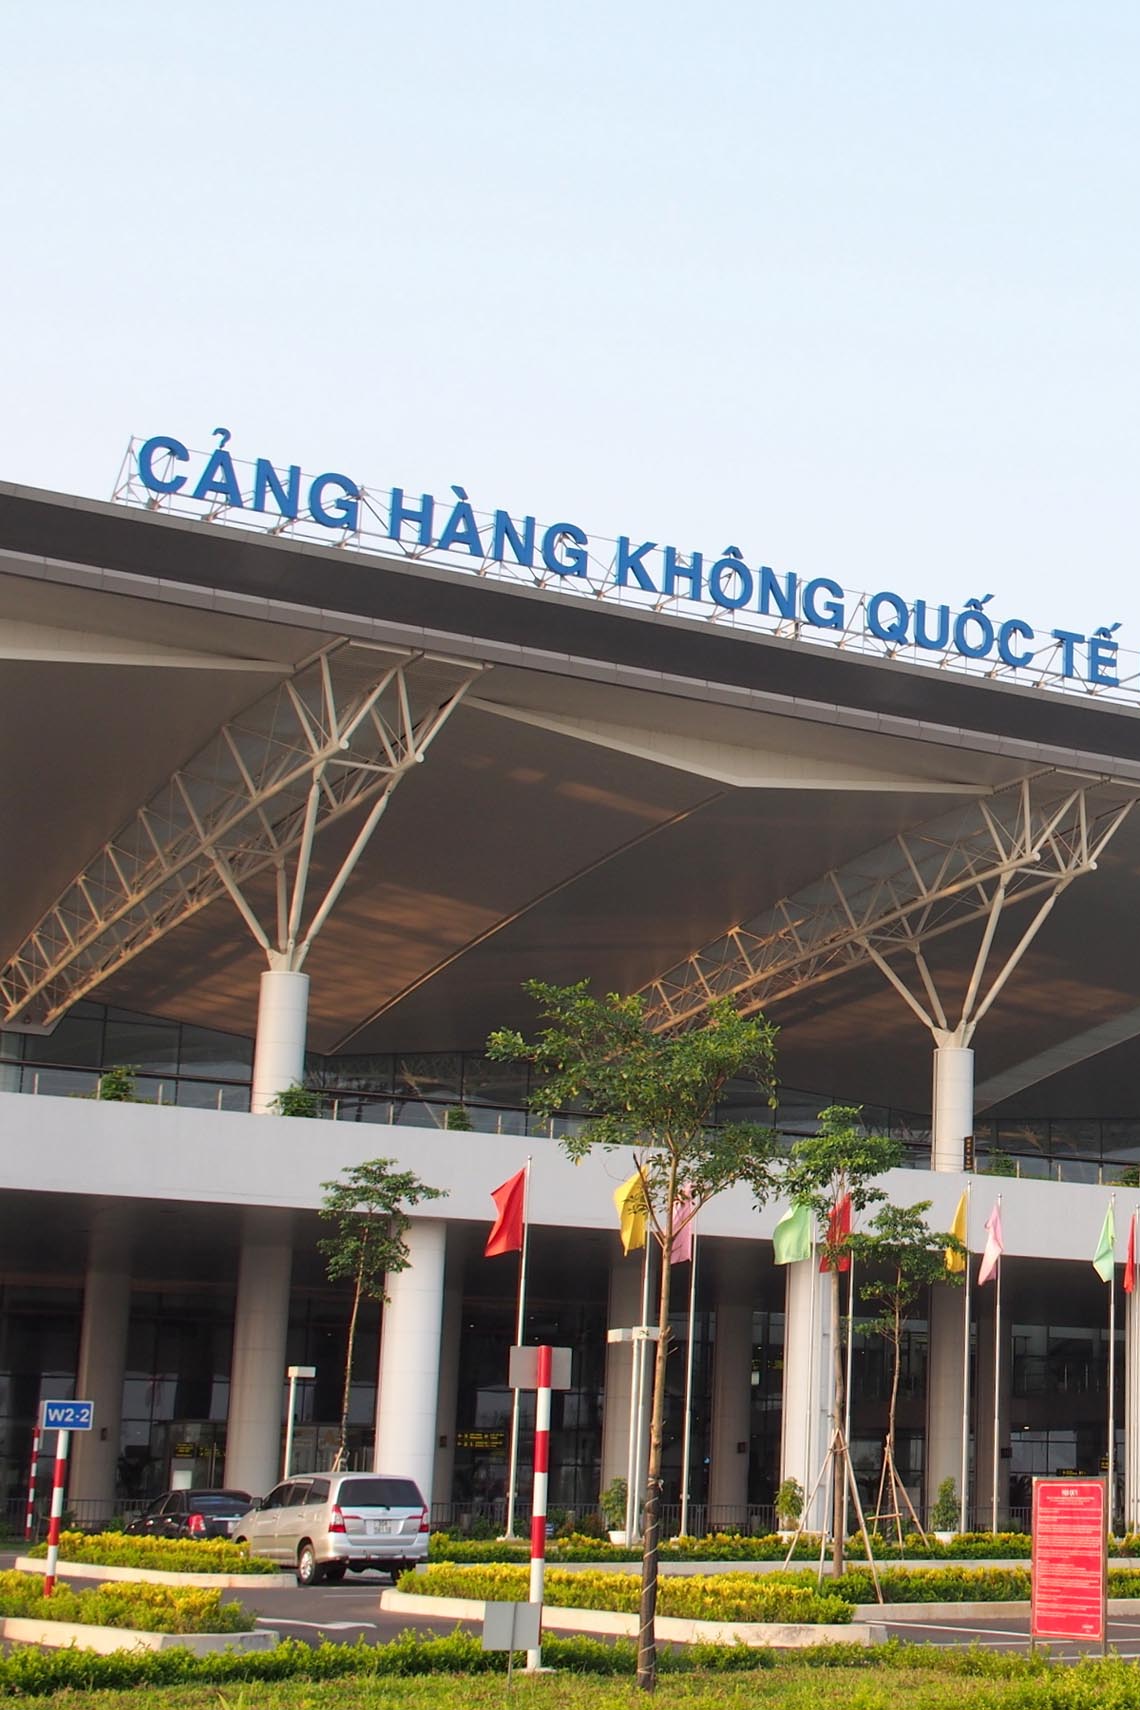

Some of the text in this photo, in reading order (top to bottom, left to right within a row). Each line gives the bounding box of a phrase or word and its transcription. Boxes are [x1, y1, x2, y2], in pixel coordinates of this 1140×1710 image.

[138, 427, 360, 532] CẢNG
[387, 485, 588, 578] HÀNG
[614, 535, 845, 629] KHÔNG
[866, 591, 1035, 669] QUỐC
[1051, 622, 1122, 687] TẾ
[48, 1408, 90, 1423] W2-2
